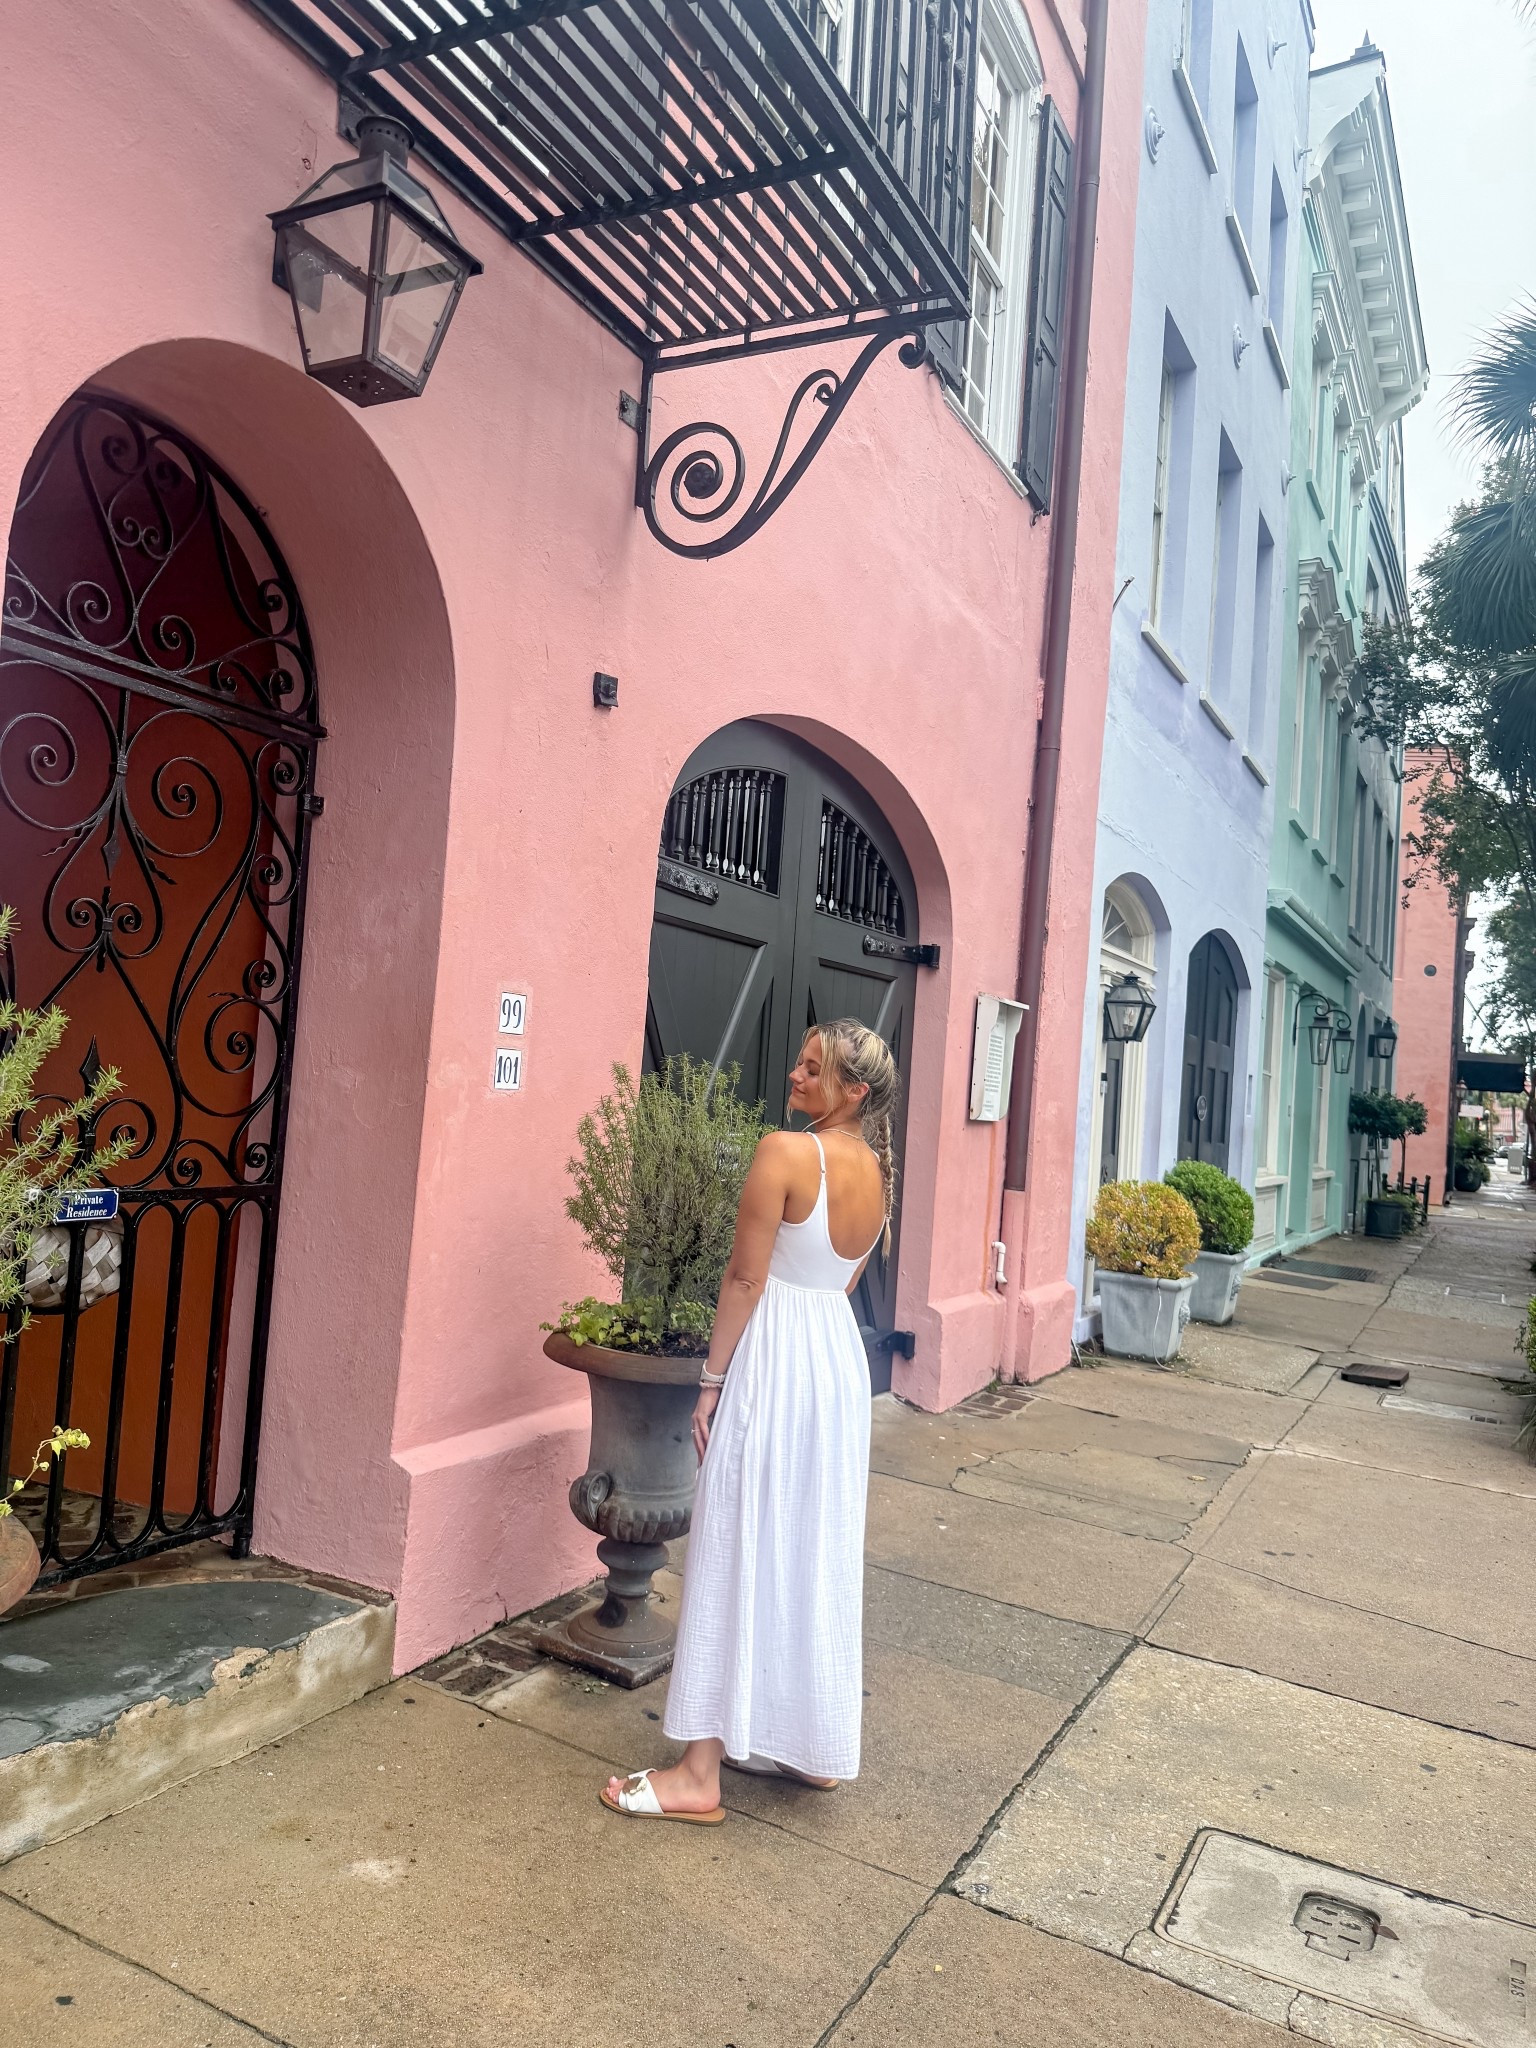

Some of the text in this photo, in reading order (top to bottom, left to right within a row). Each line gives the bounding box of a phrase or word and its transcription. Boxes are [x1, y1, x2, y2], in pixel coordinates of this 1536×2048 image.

[502, 998, 522, 1028] 99
[496, 1056, 519, 1084] 101
[74, 1194, 104, 1206] Private
[66, 1206, 108, 1218] Residence
